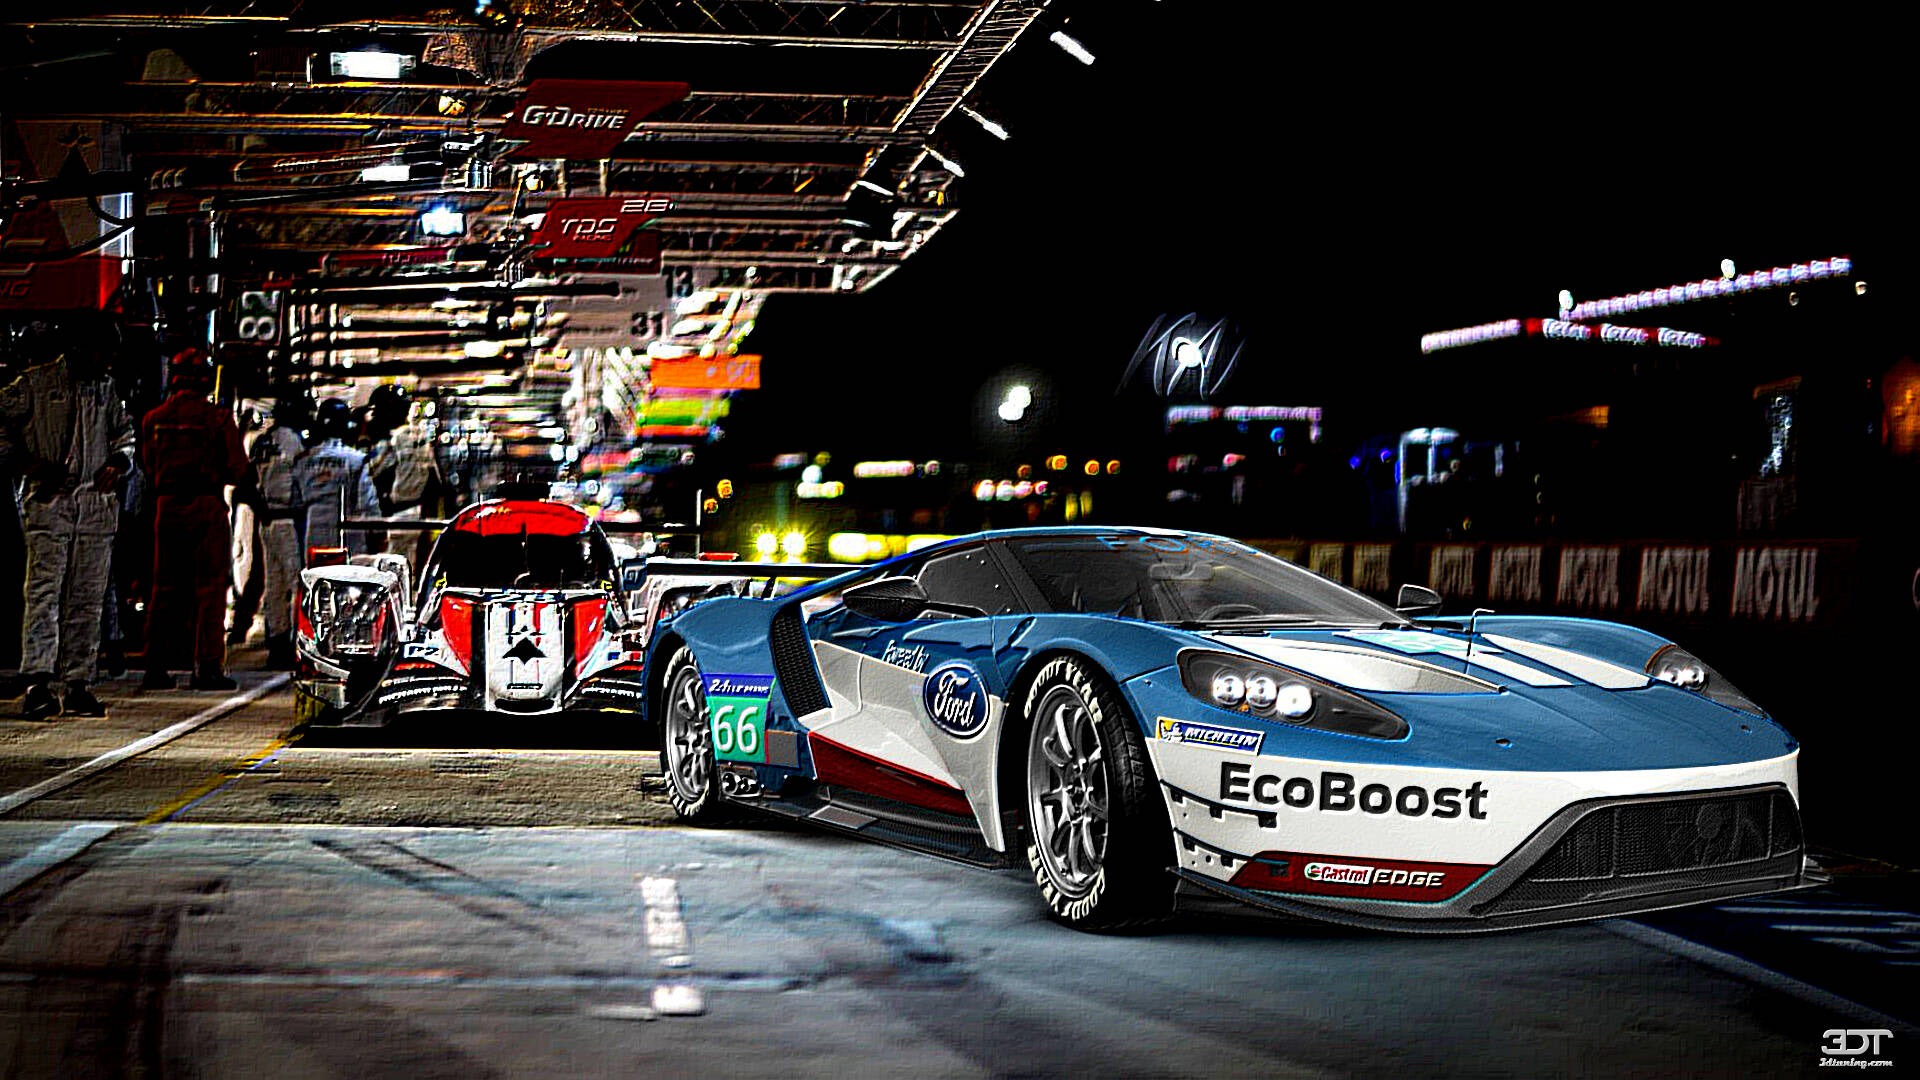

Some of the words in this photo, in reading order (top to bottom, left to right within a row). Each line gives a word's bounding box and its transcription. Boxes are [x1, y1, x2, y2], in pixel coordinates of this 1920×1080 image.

[560, 218, 618, 234] TDS
[631, 312, 665, 337] 31
[1637, 547, 1710, 618] MOTUL
[1731, 548, 1820, 622] MOTUL
[934, 670, 977, 728] Ford
[713, 704, 759, 755] 66
[1184, 727, 1259, 747] MICHELIN
[1219, 760, 1489, 821] EcoBoost
[1321, 865, 1369, 884] Castrol
[1372, 868, 1446, 888] EDGE
